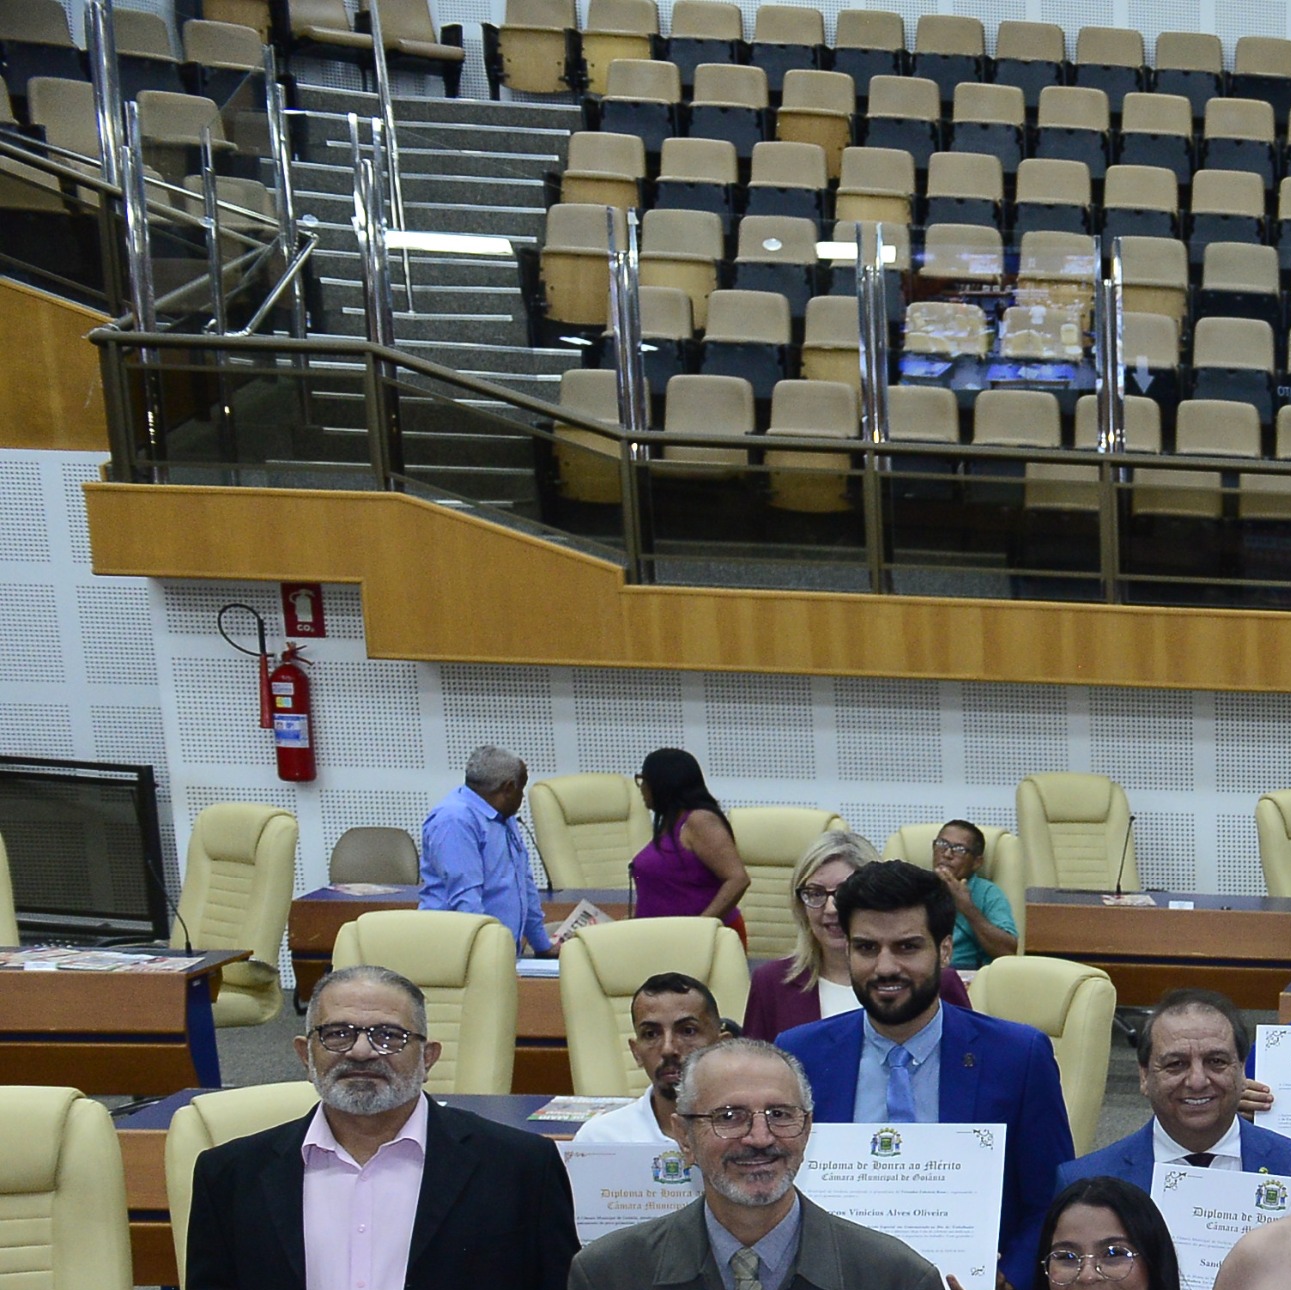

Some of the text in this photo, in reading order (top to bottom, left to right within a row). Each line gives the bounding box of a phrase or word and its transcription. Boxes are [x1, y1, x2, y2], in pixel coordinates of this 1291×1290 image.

[807, 1160, 854, 1171] Diploma
[856, 1161, 869, 1170] de
[872, 1160, 906, 1170] Honra
[923, 1160, 962, 1172] Mérito
[601, 1188, 642, 1198] Diploma
[646, 1189, 656, 1198] de
[1193, 1206, 1238, 1220] Diploma
[1241, 1212, 1253, 1223] de
[1206, 1221, 1239, 1233] Câmara
